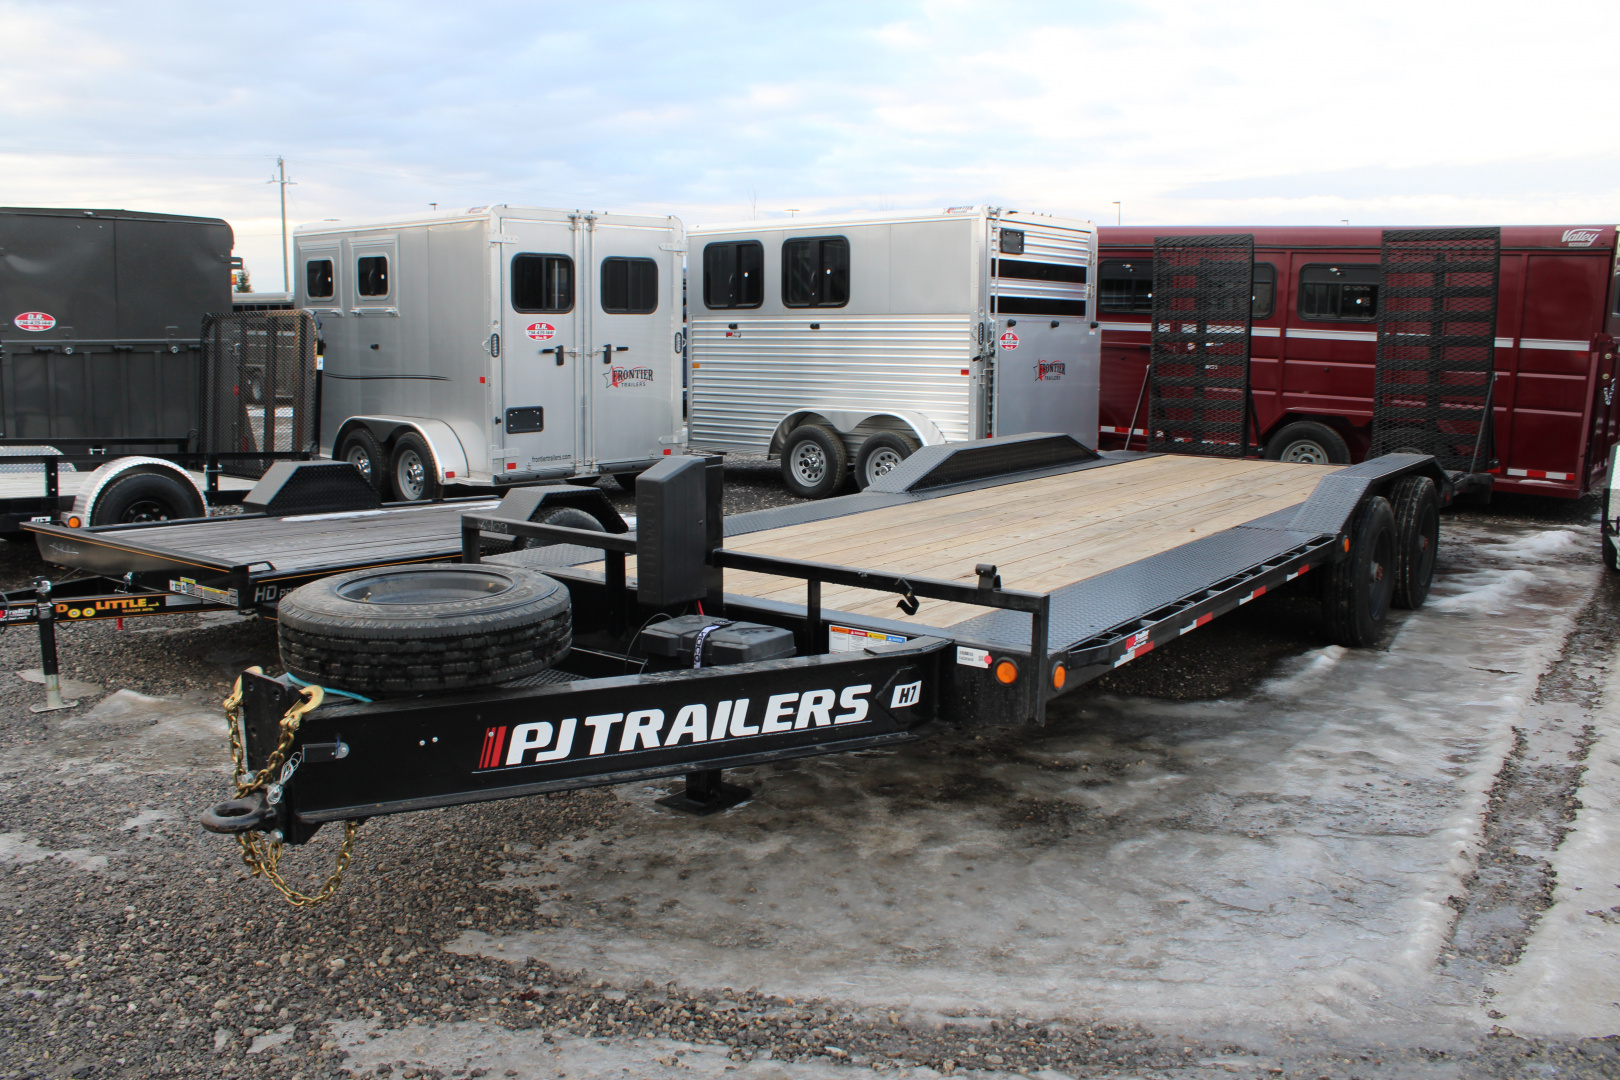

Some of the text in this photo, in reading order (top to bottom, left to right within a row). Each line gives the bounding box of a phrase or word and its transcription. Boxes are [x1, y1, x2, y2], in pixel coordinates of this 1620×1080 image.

[1561, 229, 1604, 247] Valley
[612, 368, 654, 383] FRONTIER
[254, 585, 277, 602] HD
[899, 686, 917, 704] H7
[505, 684, 872, 766] PJ TRAILERS
